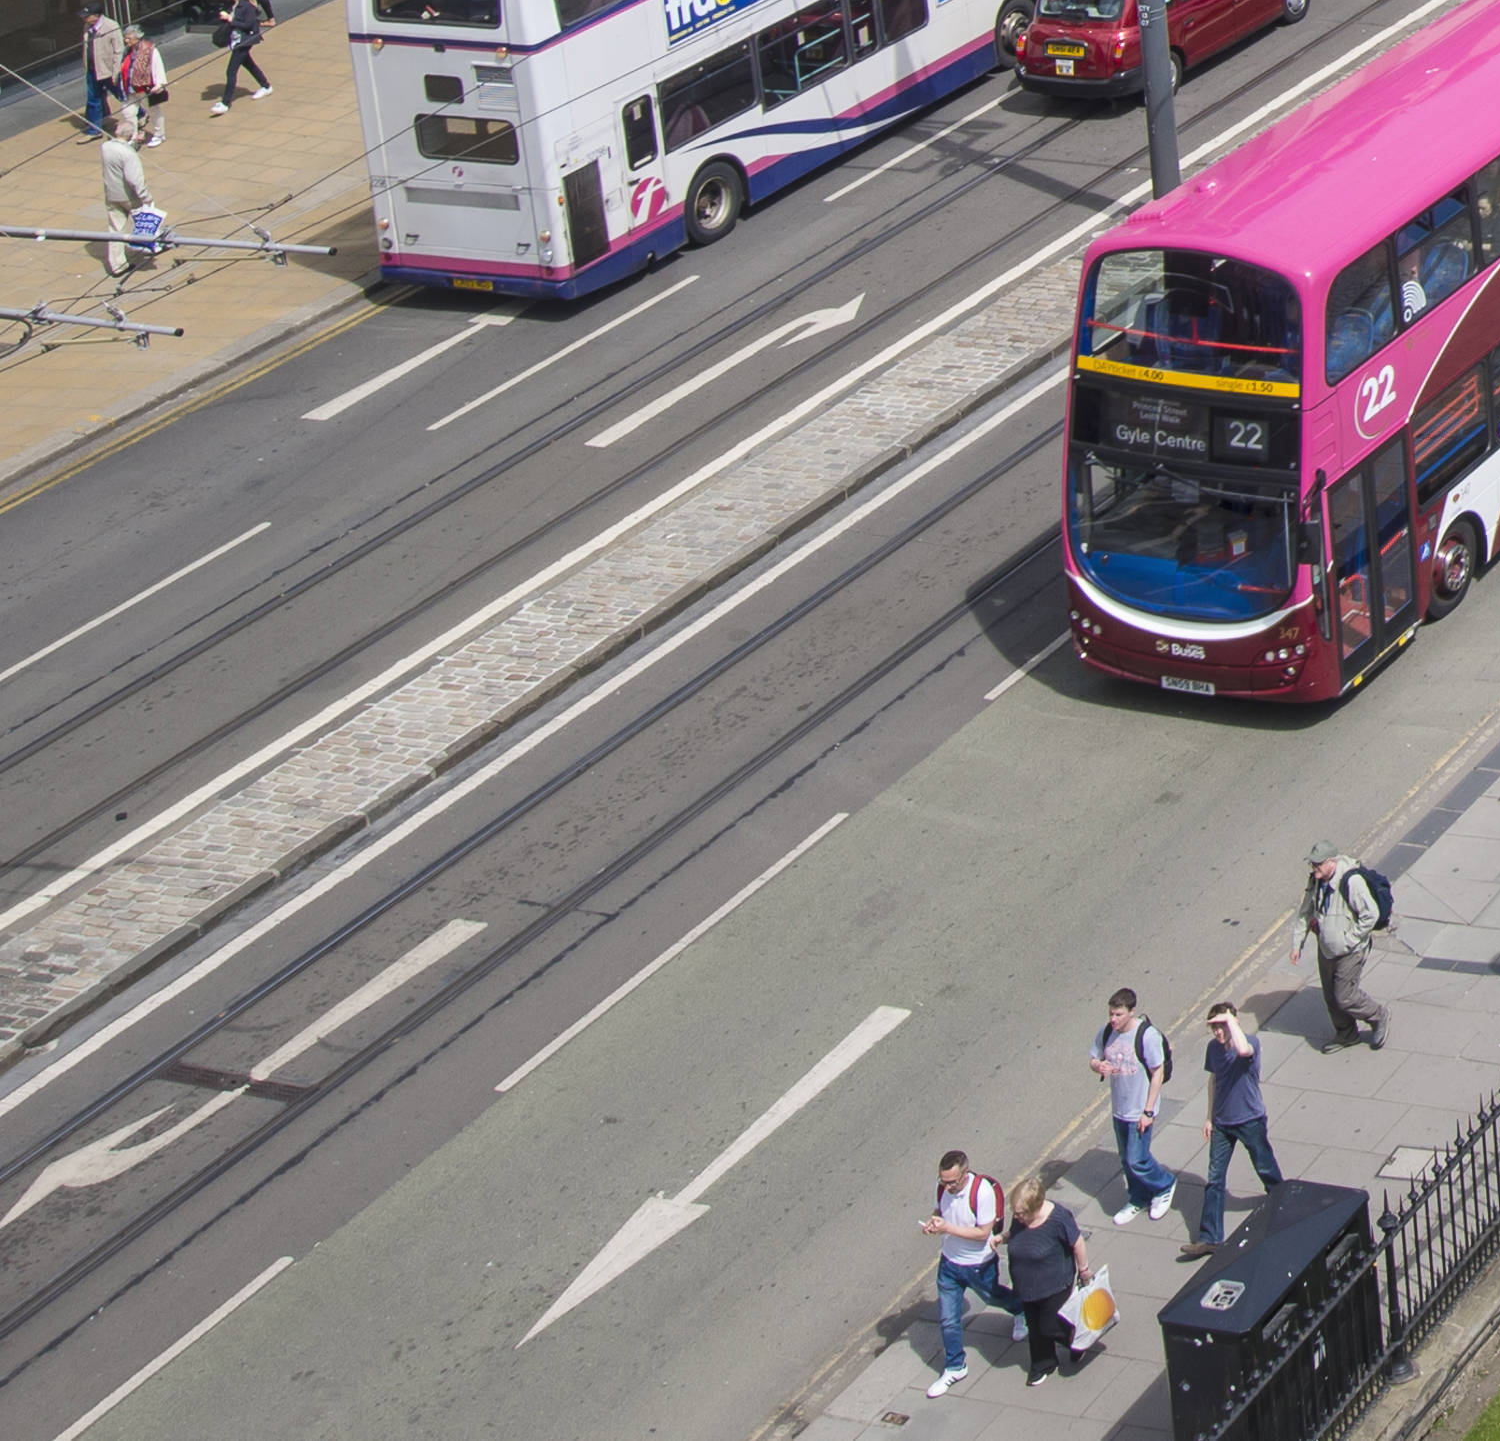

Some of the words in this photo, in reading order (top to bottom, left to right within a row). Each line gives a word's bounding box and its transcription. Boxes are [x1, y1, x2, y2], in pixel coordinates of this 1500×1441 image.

[1215, 379, 1243, 392] single
[1362, 364, 1397, 423] 22
[1163, 403, 1188, 417] Street
[1115, 424, 1150, 446] Gyle
[1154, 430, 1207, 452] Centre
[1229, 420, 1264, 450] 22
[1278, 626, 1299, 639] 347
[1171, 642, 1206, 661] Buses
